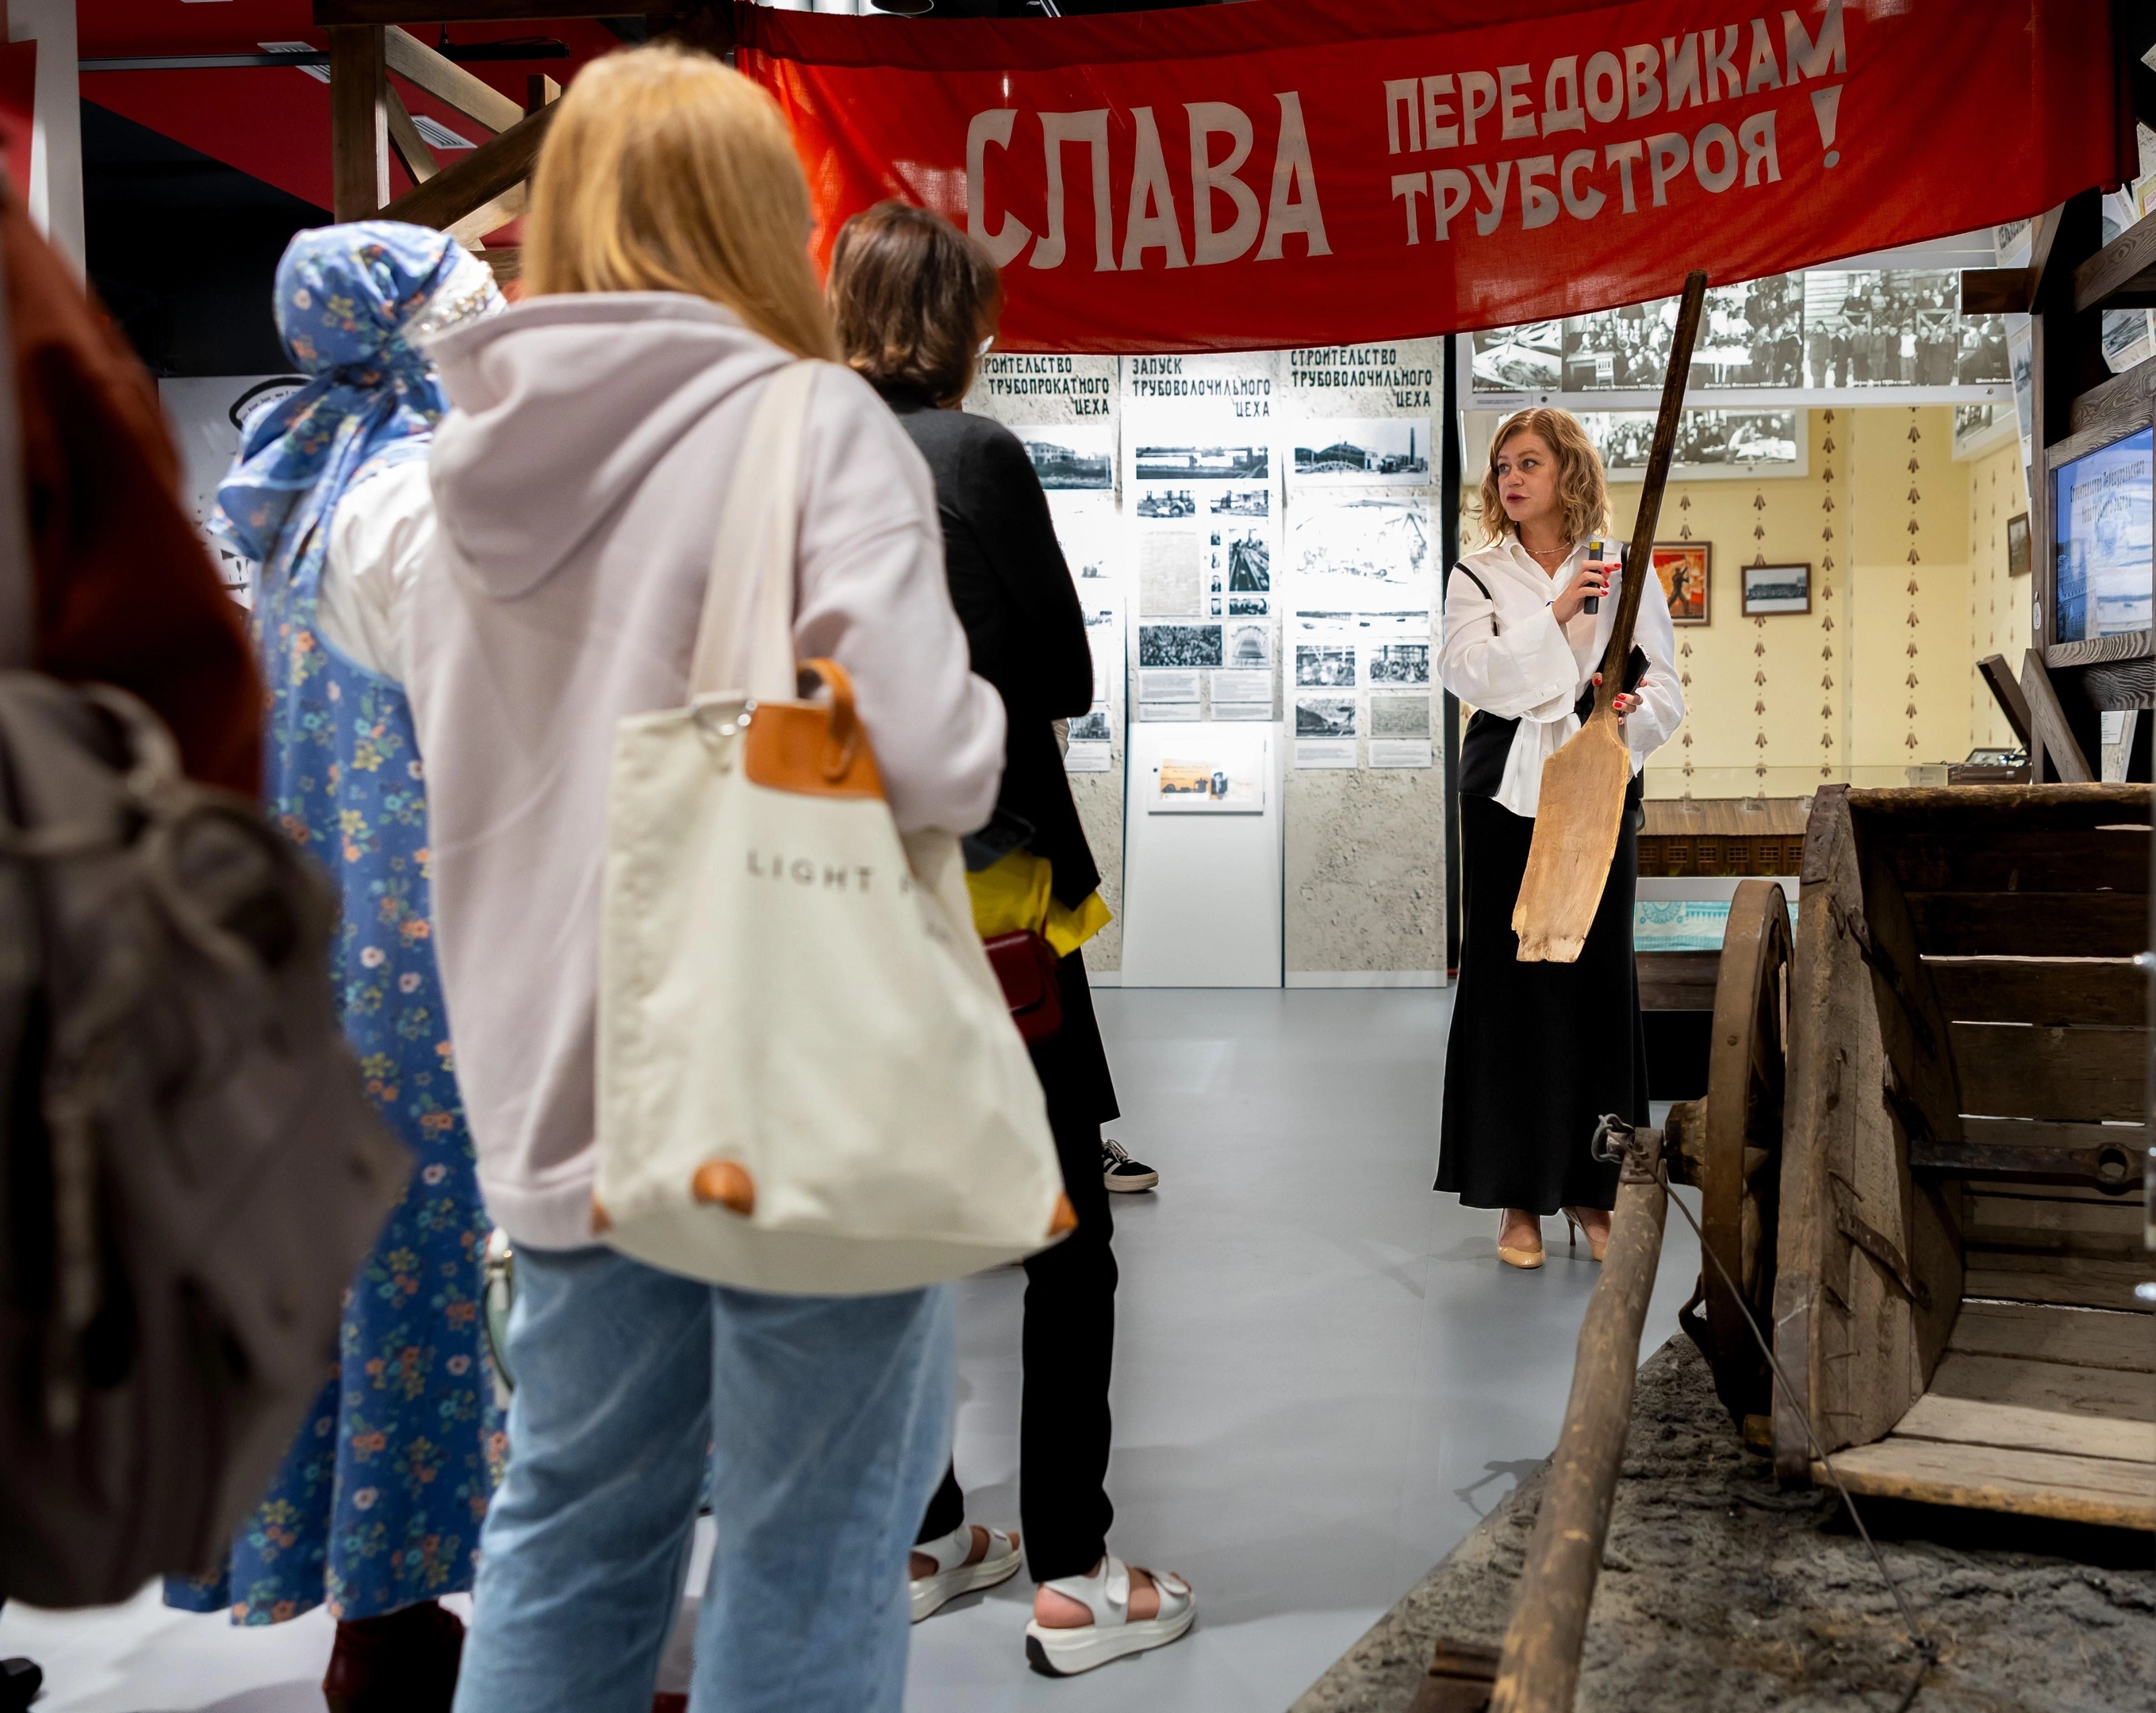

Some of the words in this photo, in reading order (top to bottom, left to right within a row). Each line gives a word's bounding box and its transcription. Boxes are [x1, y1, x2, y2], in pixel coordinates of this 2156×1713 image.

[1383, 0, 1847, 155] ПЕРЕДОВИКАМ
[966, 90, 1334, 271] СЛАВА
[1391, 109, 1782, 246] ТРУБСТРОЯ
[979, 357, 1072, 374] РОИТЕЛЬСТВО
[1133, 357, 1182, 375] ЗАПУСК
[1291, 348, 1397, 366] СТРОИТЕЛЬСТВО
[988, 377, 1110, 395] ТРУБОПРОКАТНОГО
[1133, 378, 1272, 397] ТРУБОВОЛОЧИЛЬНОГО
[1291, 370, 1433, 388] ТРУБОВОЛОЧИЛЬНОГО
[1075, 398, 1110, 416] ЦЕХА
[1396, 390, 1431, 408] ЦЕХА
[1236, 400, 1270, 417] ЦЕХА
[746, 847, 874, 894] LIGHT
